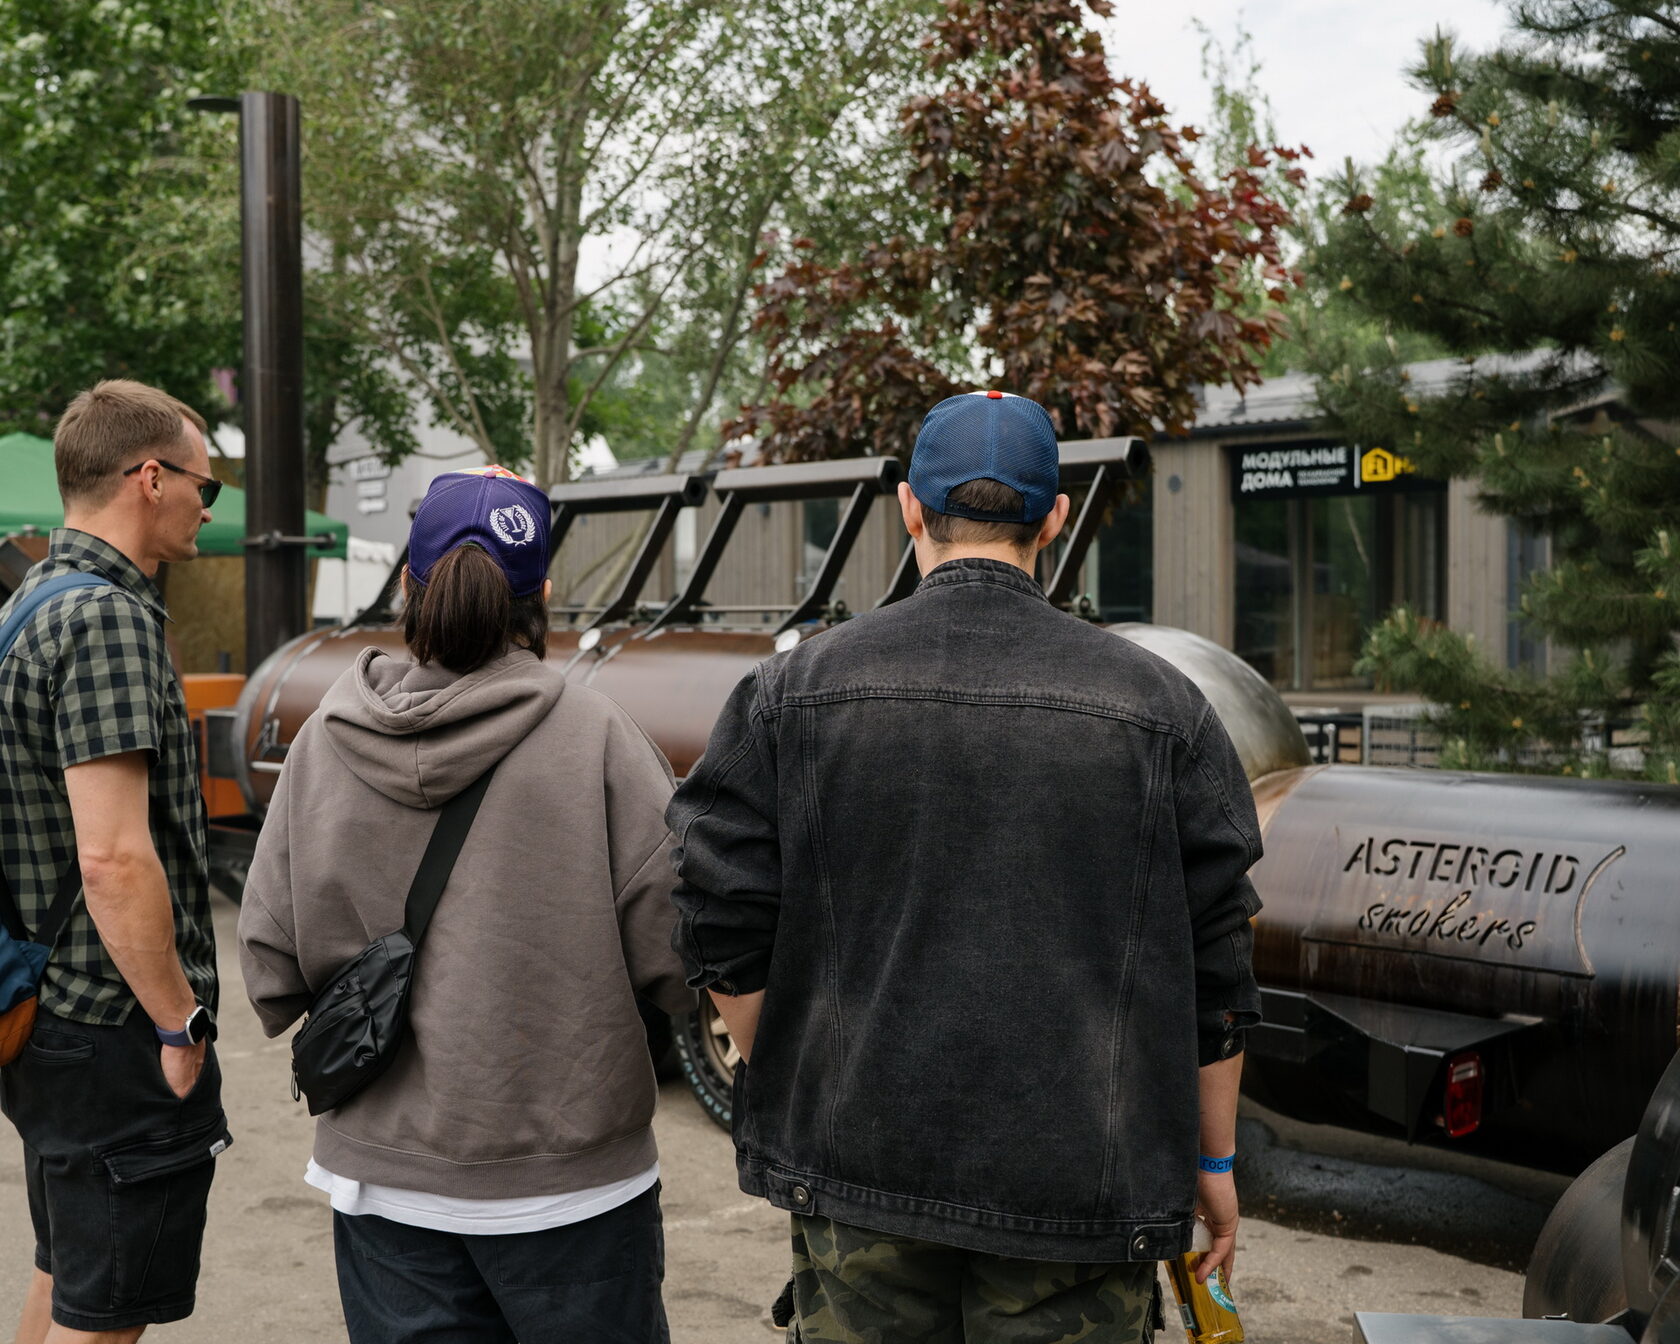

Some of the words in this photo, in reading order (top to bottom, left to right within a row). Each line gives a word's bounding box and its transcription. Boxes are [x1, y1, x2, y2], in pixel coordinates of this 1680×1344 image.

[1242, 447, 1347, 471] МОДУЛЬНЫЕ
[1241, 470, 1294, 492] ДОМА
[1343, 837, 1580, 894] ASTEROID
[1358, 890, 1536, 950] smokers
